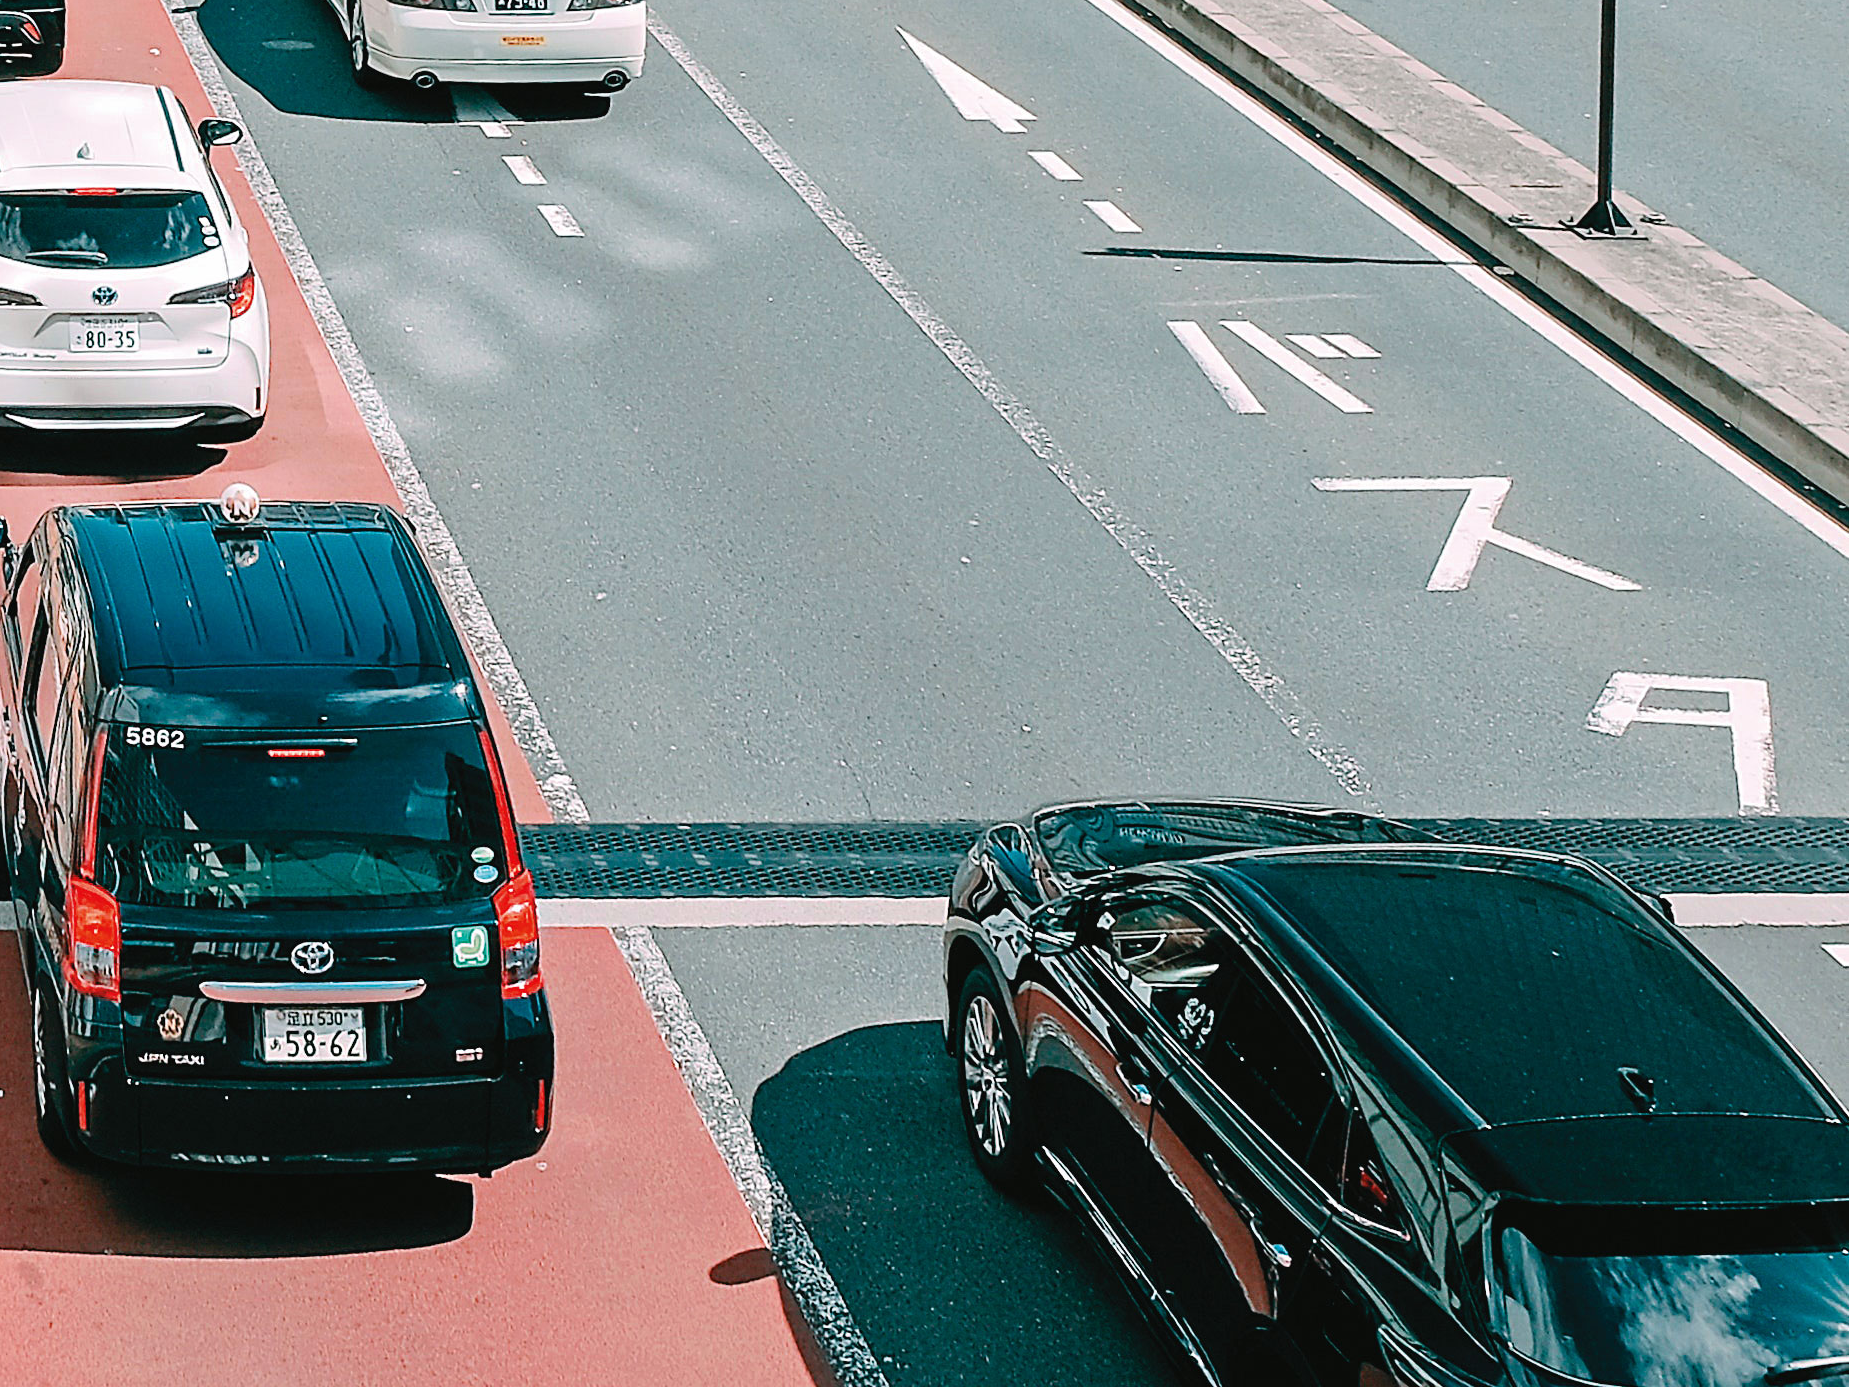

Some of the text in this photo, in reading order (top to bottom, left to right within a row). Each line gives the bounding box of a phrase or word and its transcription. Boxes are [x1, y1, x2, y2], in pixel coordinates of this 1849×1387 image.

[85, 330, 136, 349] 80-35
[126, 726, 185, 750] 5862
[316, 1011, 345, 1026] 530
[286, 1030, 362, 1059] 58-62
[138, 1054, 169, 1066] JPN
